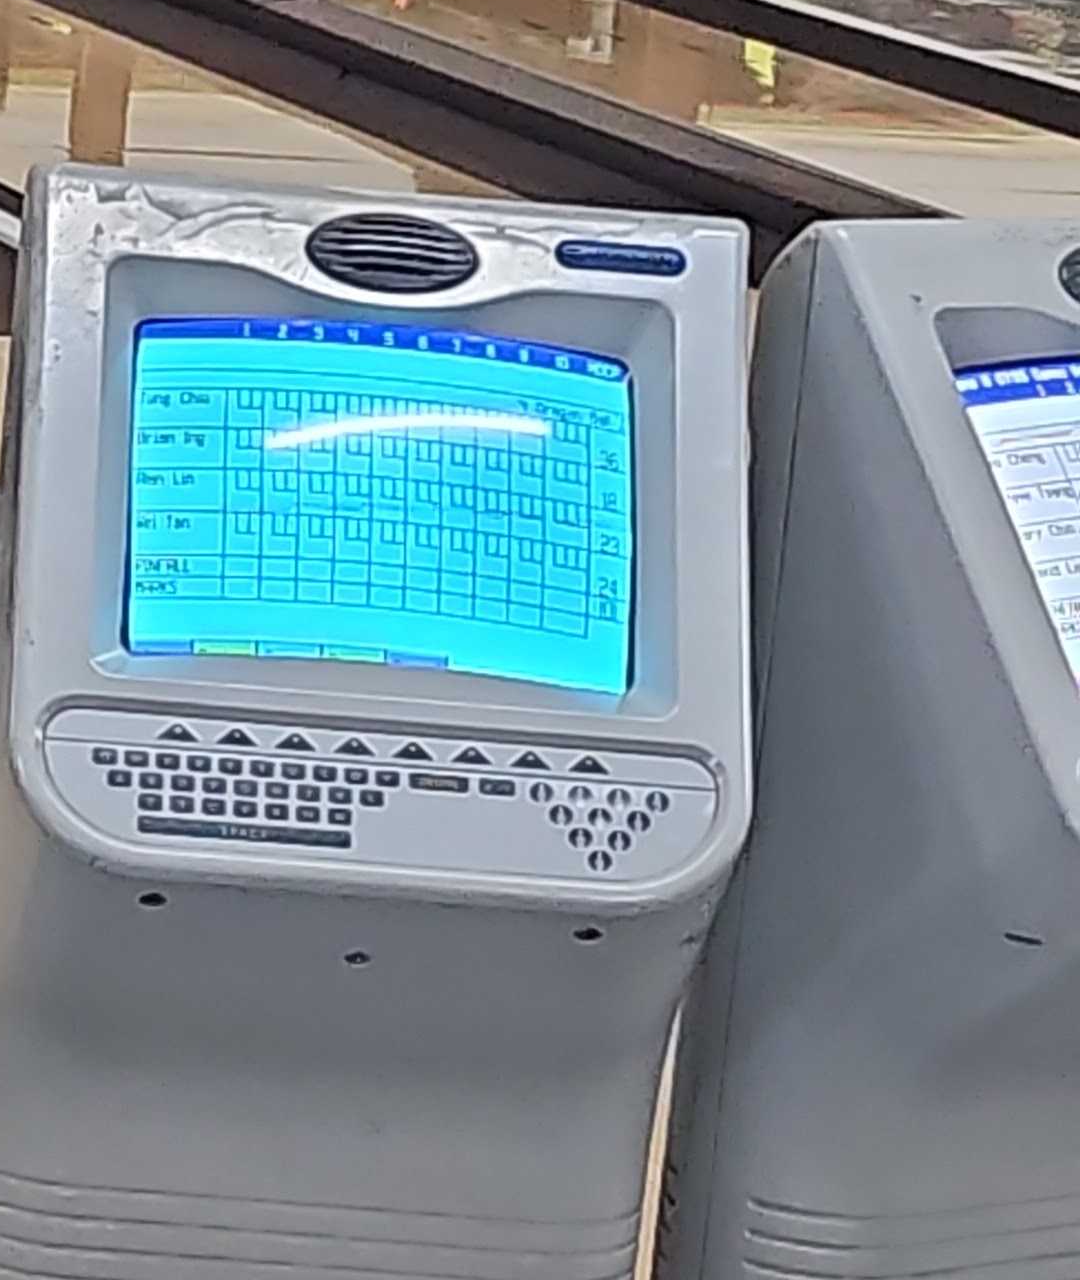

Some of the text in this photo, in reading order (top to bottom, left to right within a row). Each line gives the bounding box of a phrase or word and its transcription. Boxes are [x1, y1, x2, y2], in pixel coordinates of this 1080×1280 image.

[242, 322, 252, 337] 1
[277, 323, 289, 338] 2
[347, 328, 359, 342] 4
